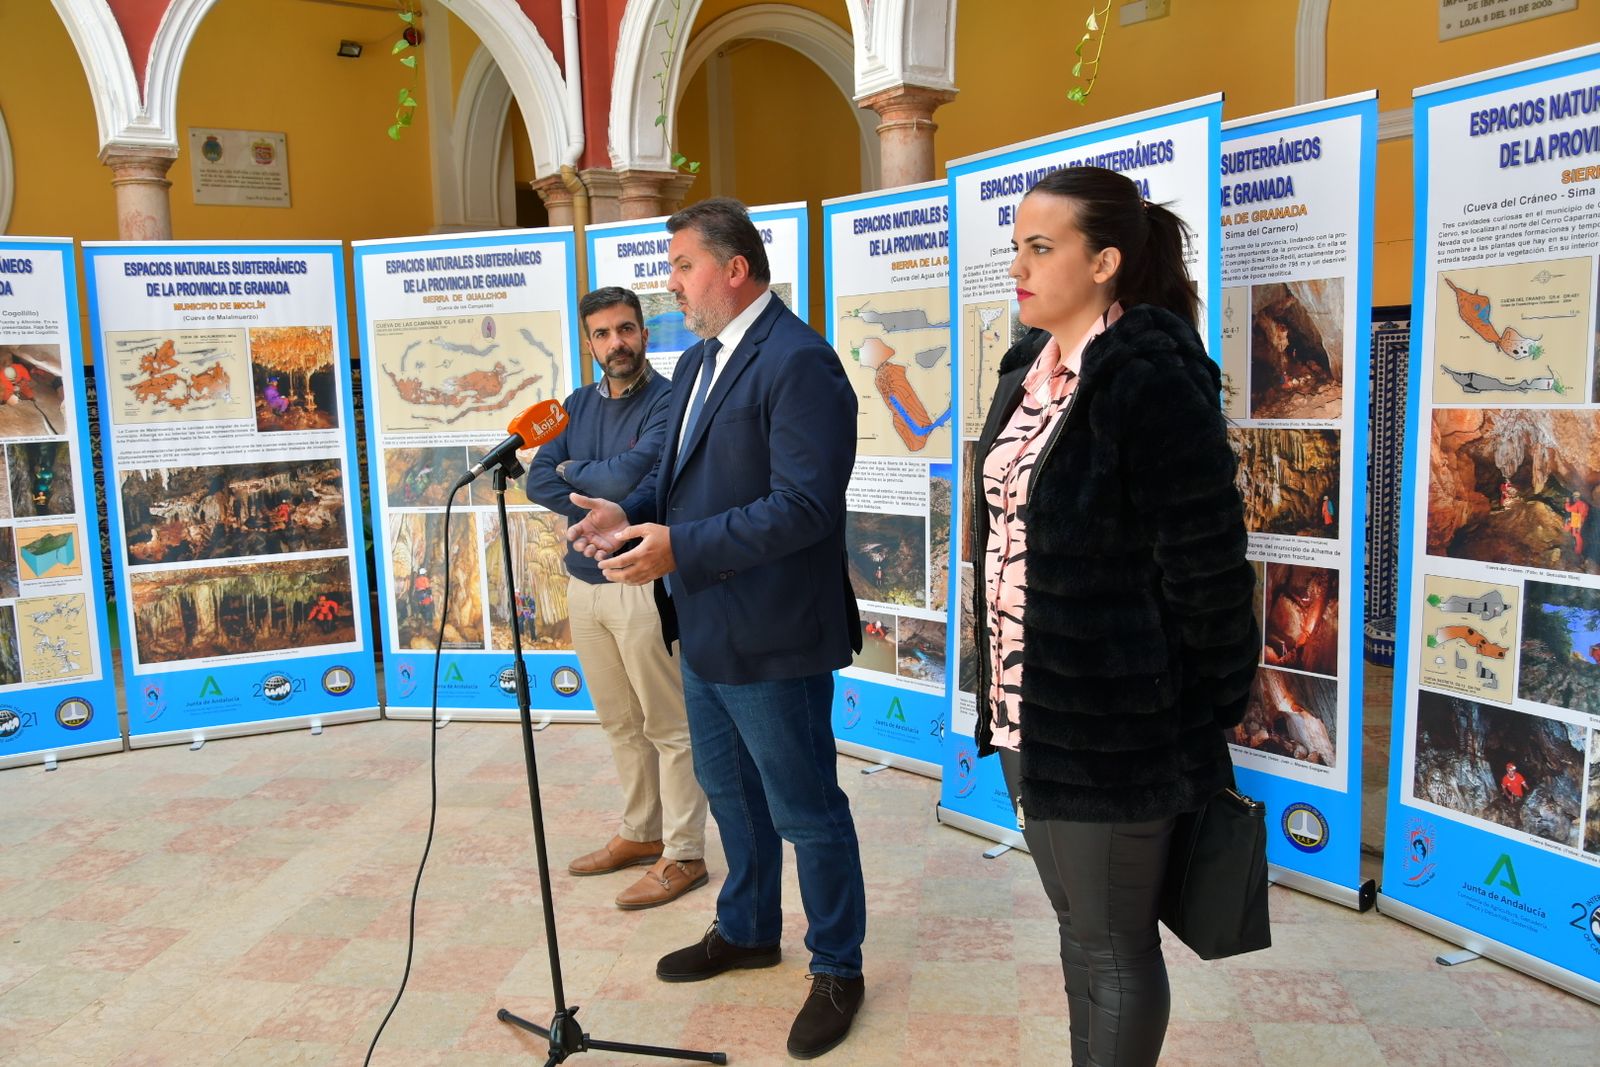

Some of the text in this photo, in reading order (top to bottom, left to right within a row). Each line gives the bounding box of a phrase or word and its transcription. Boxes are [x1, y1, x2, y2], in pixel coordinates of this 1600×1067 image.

[1460, 16, 1480, 28] LOJA
[1491, 10, 1507, 20] DEL
[1518, 4, 1529, 14] DE
[1469, 97, 1545, 137] ESPACIOS
[1221, 137, 1321, 175] SUBTERRÁNEOS
[1499, 125, 1600, 169] DE LA PROVI
[980, 172, 1024, 201] ESPACIOS
[1234, 176, 1294, 205] GRANADA
[1463, 201, 1498, 215] (Cueva
[1501, 197, 1516, 208] del
[1519, 193, 1558, 206] Cráneo
[1567, 187, 1596, 198] Sima
[853, 205, 941, 235] ESPACIOS NATURALES
[998, 206, 1011, 227] DE
[1234, 204, 1308, 225] DE GRANADA
[1457, 218, 1490, 228] cavidades
[1492, 214, 1522, 222] curiosas
[1546, 205, 1582, 215] municipio
[1225, 223, 1299, 240] Sima del Carnero)
[1470, 225, 1500, 234] localizan
[1509, 221, 1527, 229] norte
[1494, 232, 1522, 241] grandes
[1525, 226, 1569, 236] formaciones
[617, 241, 656, 257] ESPACIOS
[869, 240, 880, 257] DE
[881, 238, 893, 255] LA
[893, 231, 938, 254] PROVINCIA
[1491, 241, 1515, 250] plantas
[1571, 232, 1599, 240] interior.
[386, 248, 542, 274] ESPACIOS NATURALES SUBTERRÁNEOS
[919, 257, 930, 268] DE
[931, 256, 942, 267] LA
[1437, 256, 1460, 264] entrada
[1461, 253, 1484, 261] tapada
[1507, 246, 1546, 257] vegetación.
[1571, 241, 1599, 249] interior
[124, 257, 307, 276] ESPACIOS NATURALES SUBTERRÁNEOS
[634, 262, 657, 278] DE LA
[146, 281, 290, 297] DE LA PROVINCIA DE GRANADA
[404, 273, 526, 293] DE LA PROVINCIA DE GRANADA
[173, 302, 218, 311] MUNICIPIO
[219, 302, 232, 310] DE
[452, 294, 462, 302] DE
[550, 403, 565, 422] 2
[1462, 882, 1486, 896] Junta
[1488, 891, 1499, 900] de
[1500, 895, 1546, 918] Andalucía
